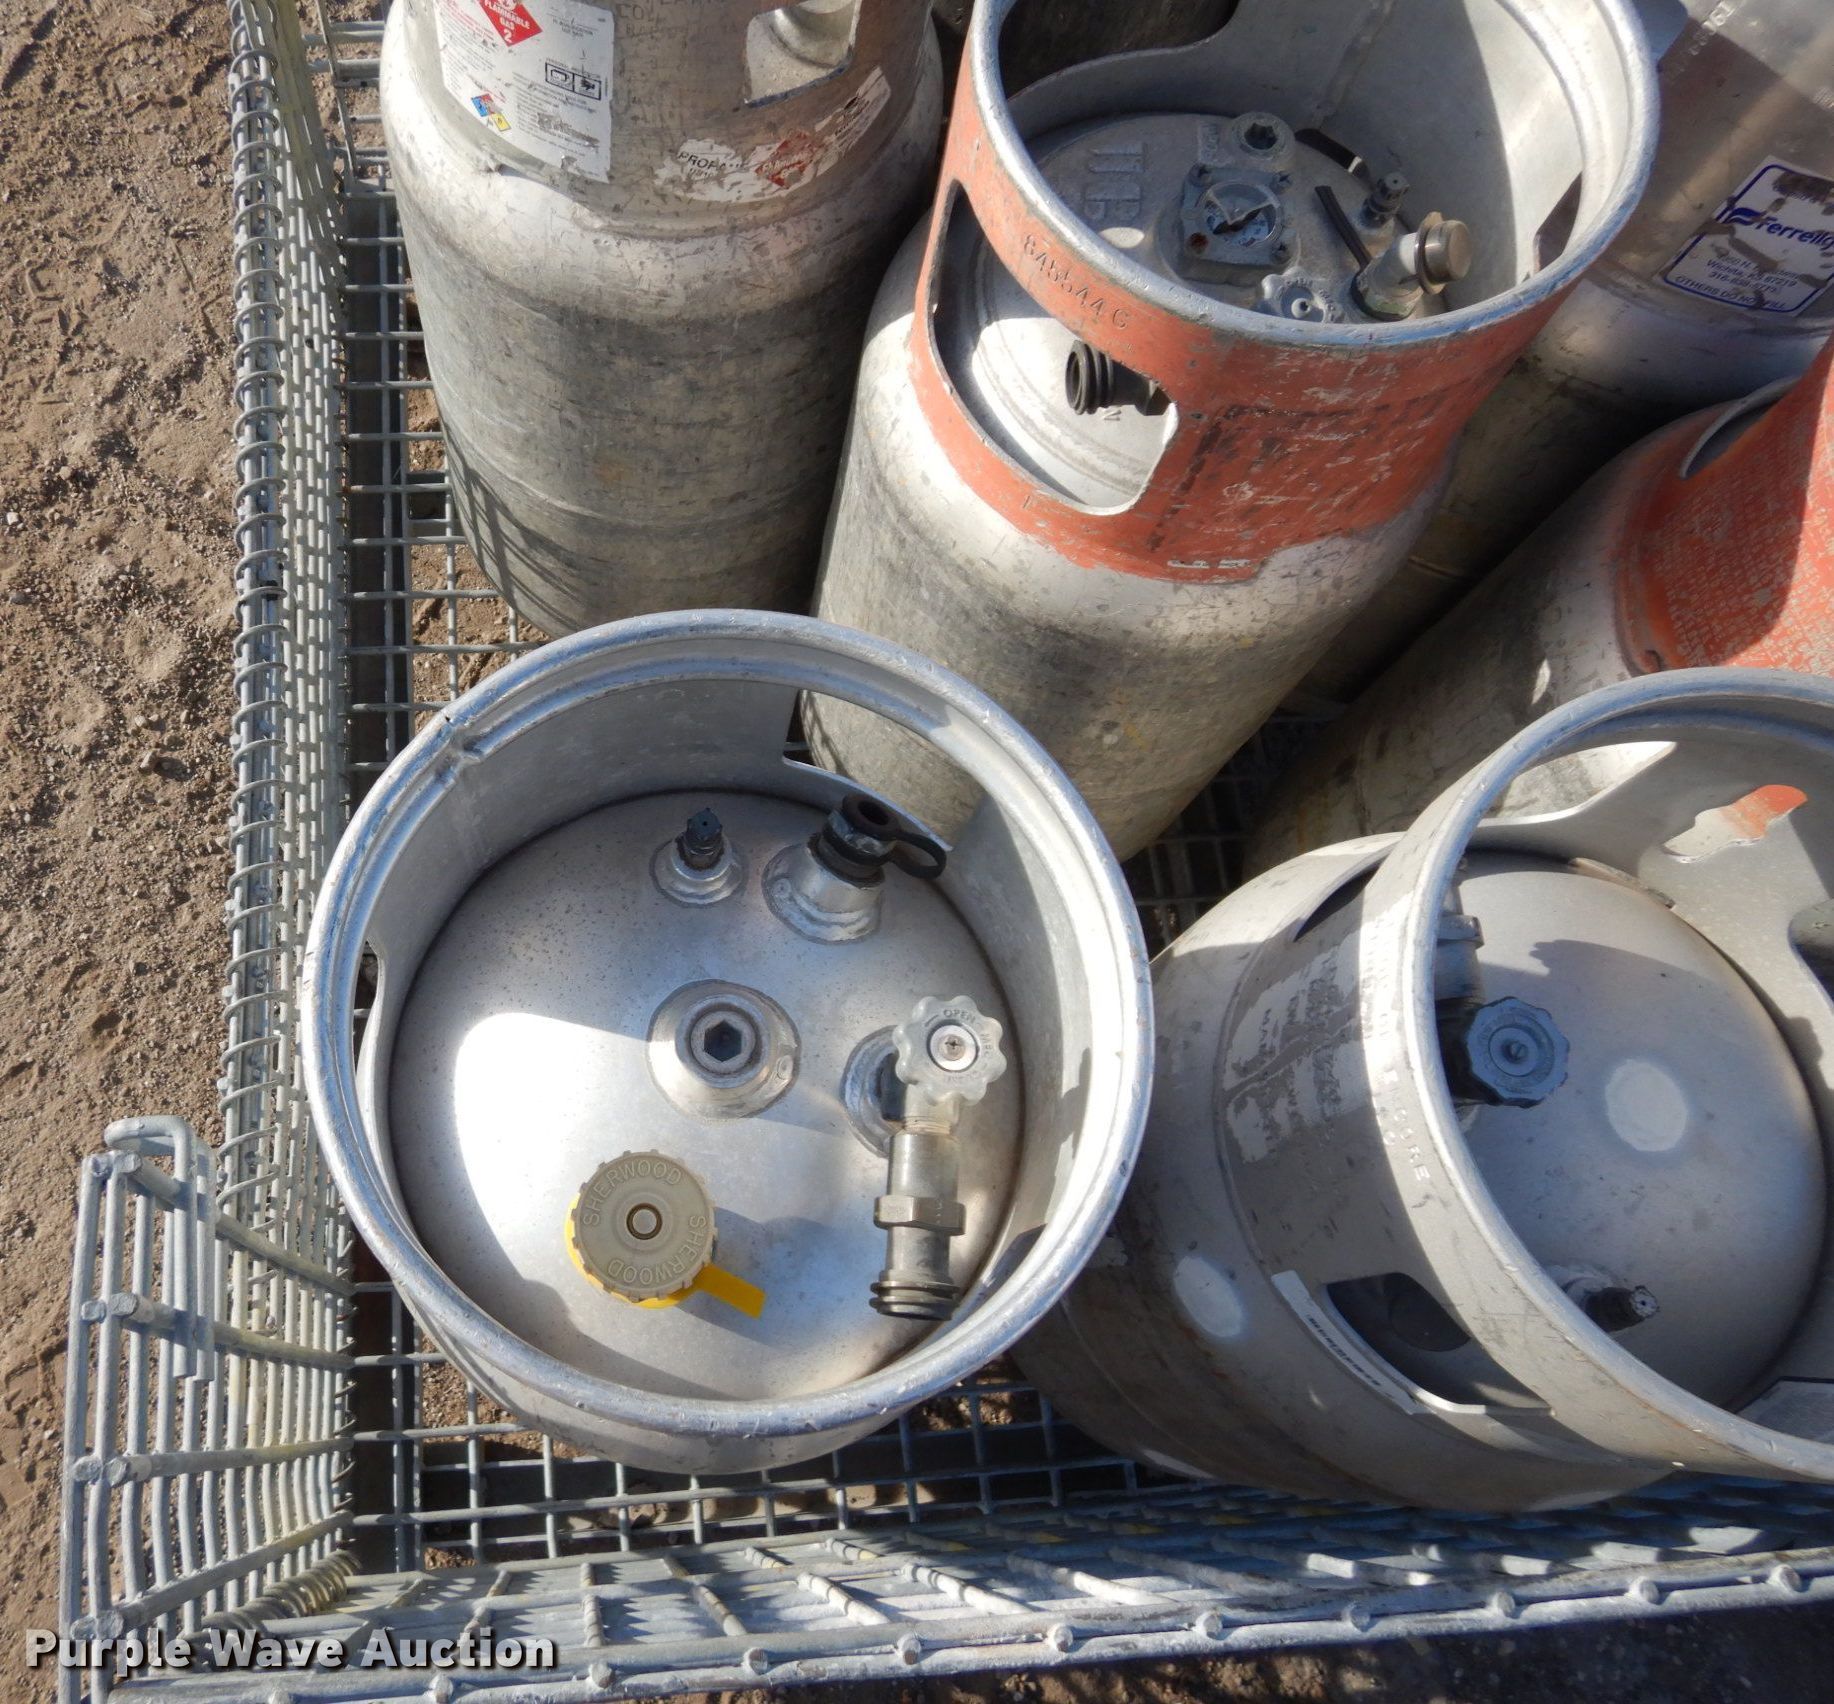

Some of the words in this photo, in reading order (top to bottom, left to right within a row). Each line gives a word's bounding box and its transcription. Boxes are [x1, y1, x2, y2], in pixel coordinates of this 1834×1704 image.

[503, 28, 513, 43] 2
[582, 1159, 682, 1227] SHERWOOD
[607, 1215, 707, 1285] SHERWOOD
